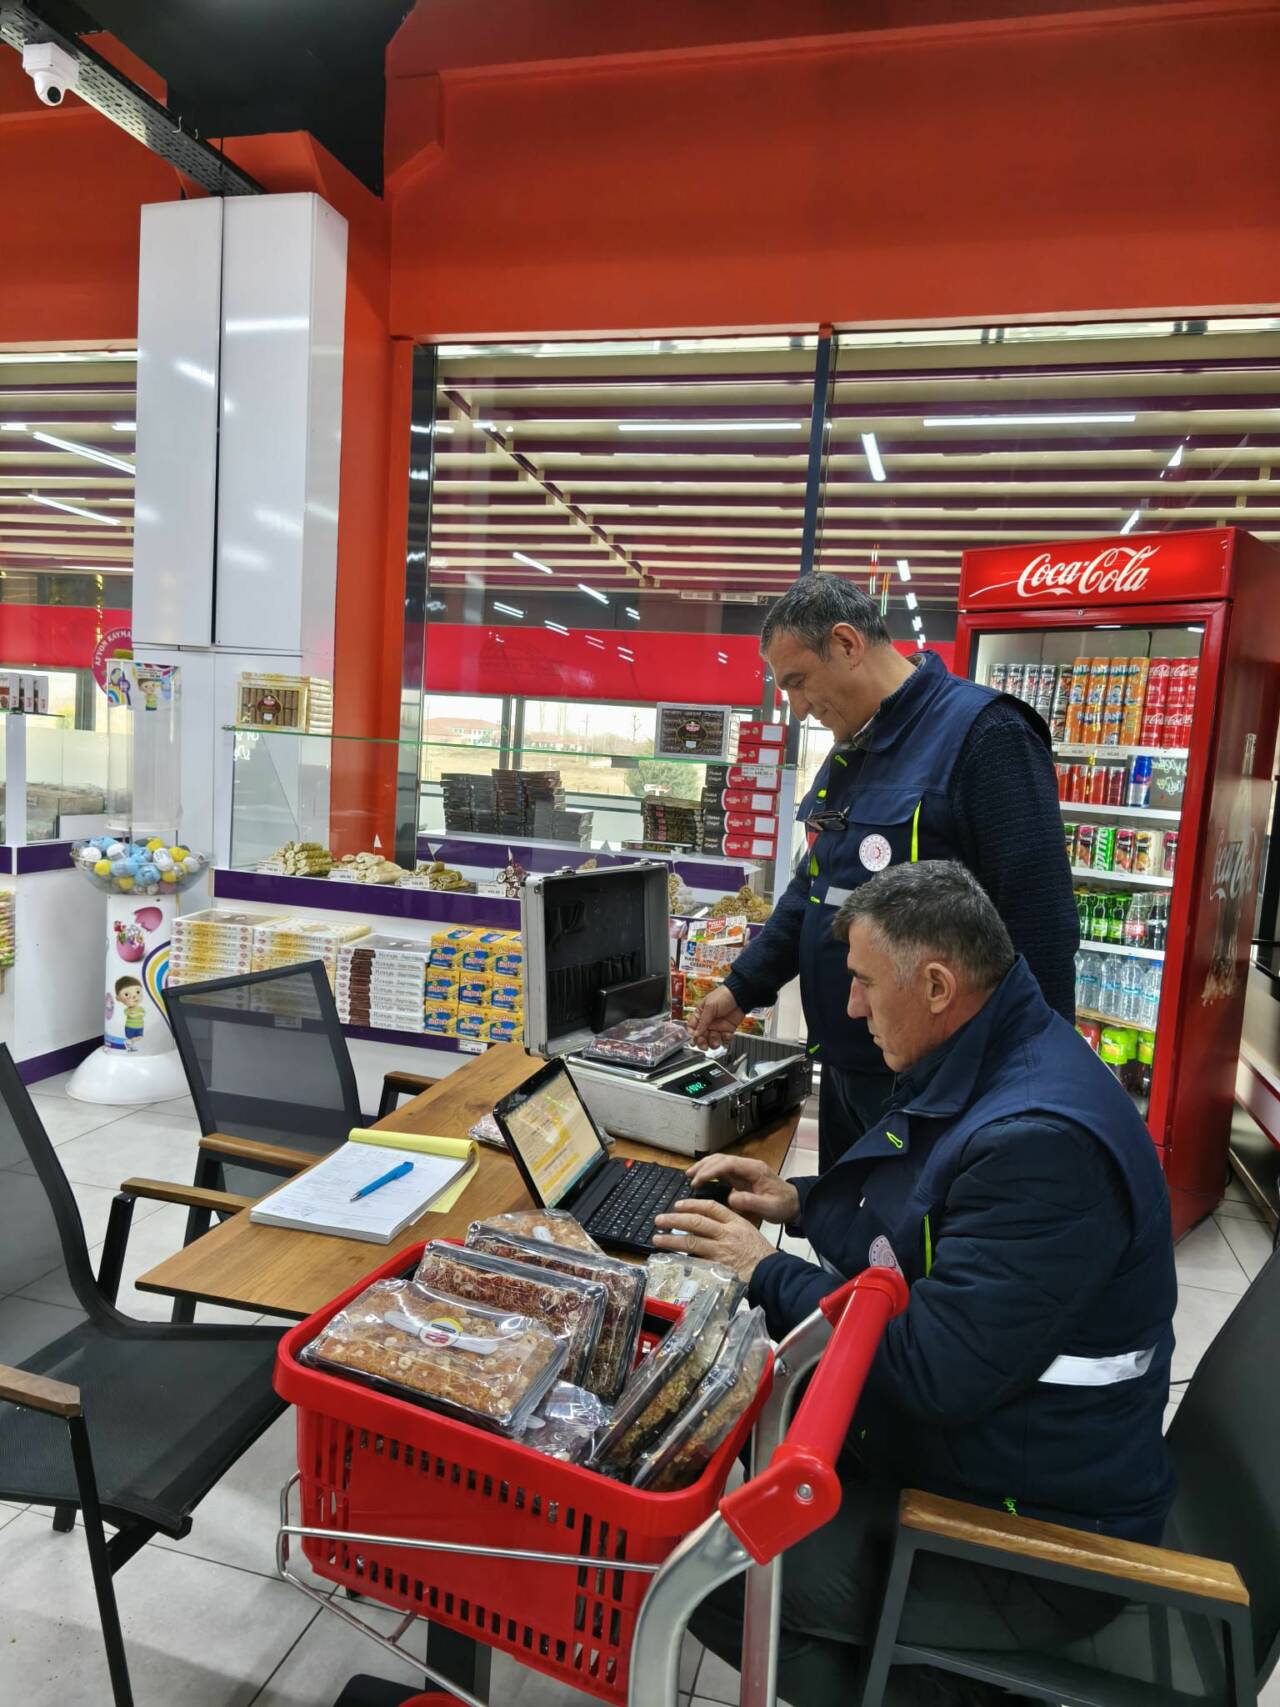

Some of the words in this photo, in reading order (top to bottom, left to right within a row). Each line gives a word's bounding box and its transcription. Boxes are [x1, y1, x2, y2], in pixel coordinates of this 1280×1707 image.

[1014, 545, 1160, 598] Coca-Cola
[95, 640, 108, 666] AFYON
[107, 630, 132, 643] KAYMA
